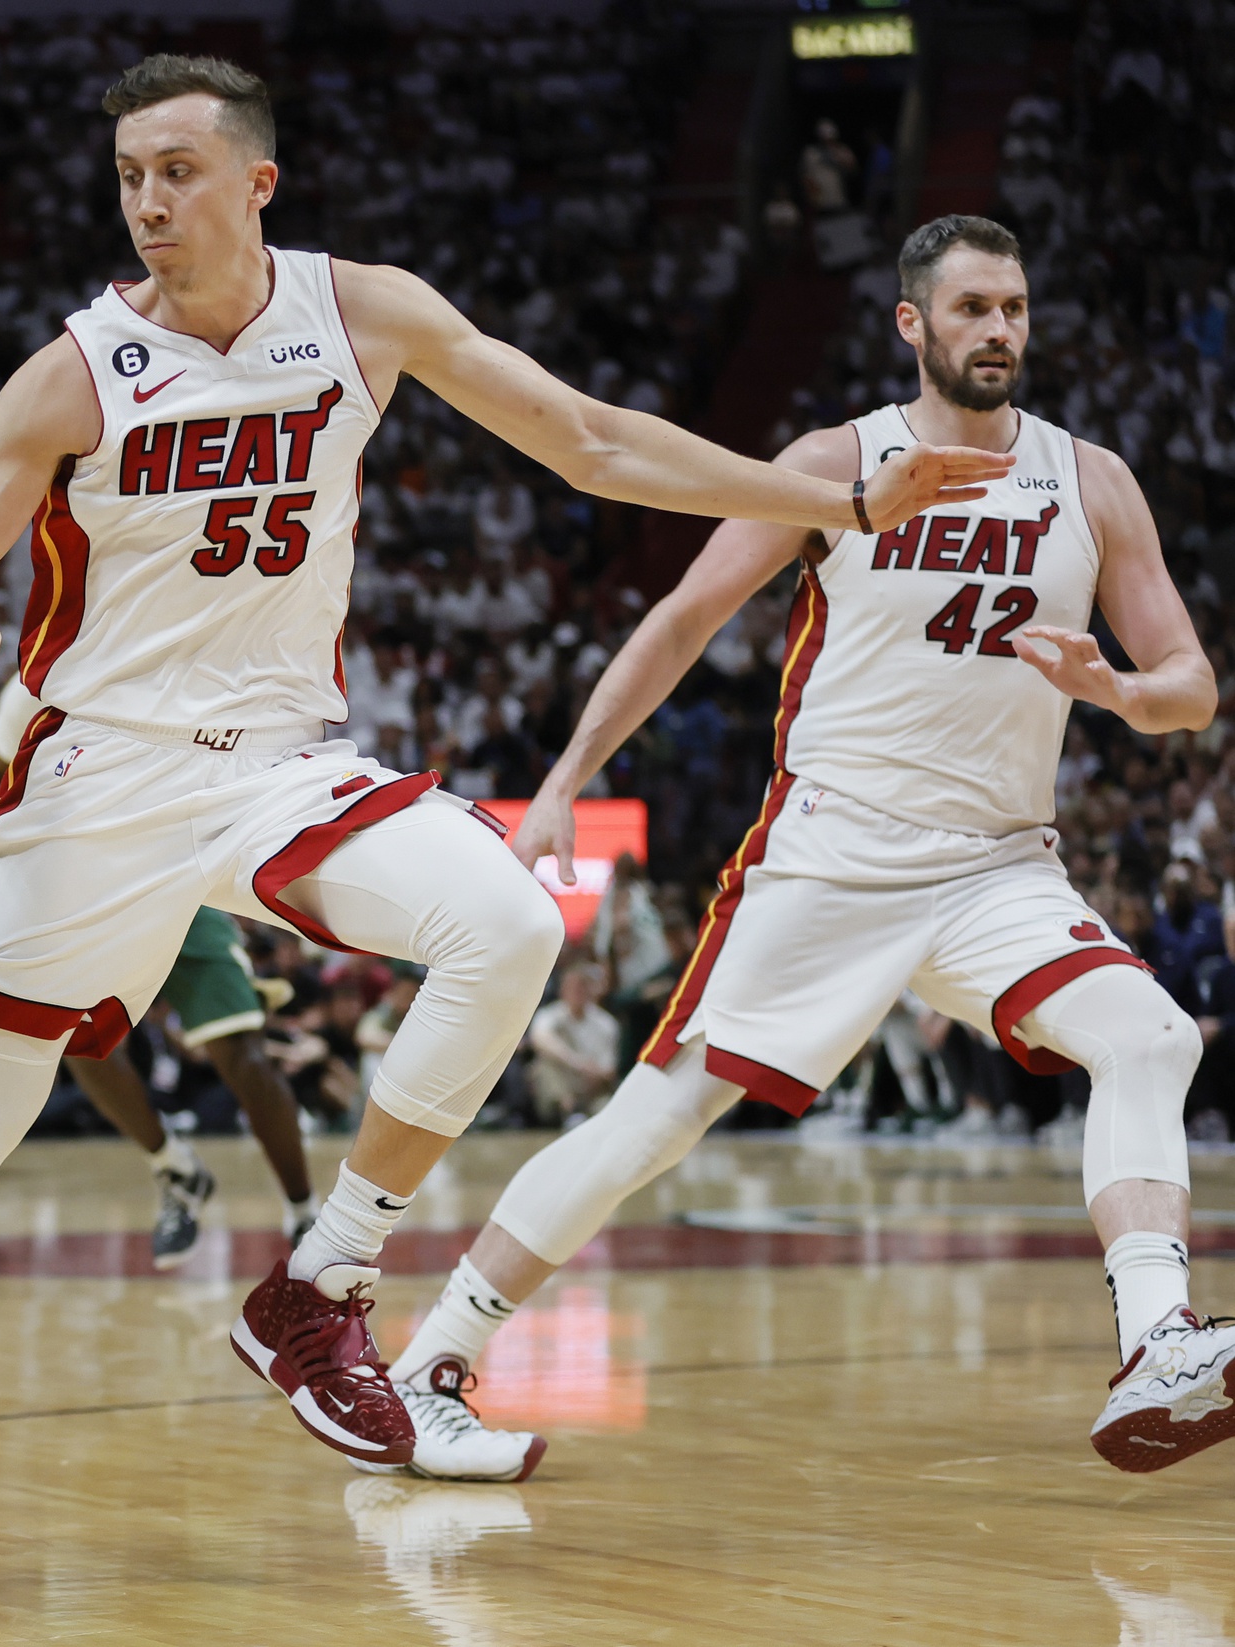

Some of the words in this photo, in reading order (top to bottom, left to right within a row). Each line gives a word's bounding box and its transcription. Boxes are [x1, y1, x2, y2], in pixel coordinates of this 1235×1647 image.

[120, 346, 143, 374] 6
[119, 378, 344, 496] HEAT
[190, 490, 317, 578] 55
[871, 500, 1060, 576] HEAT
[925, 583, 1039, 658] 42
